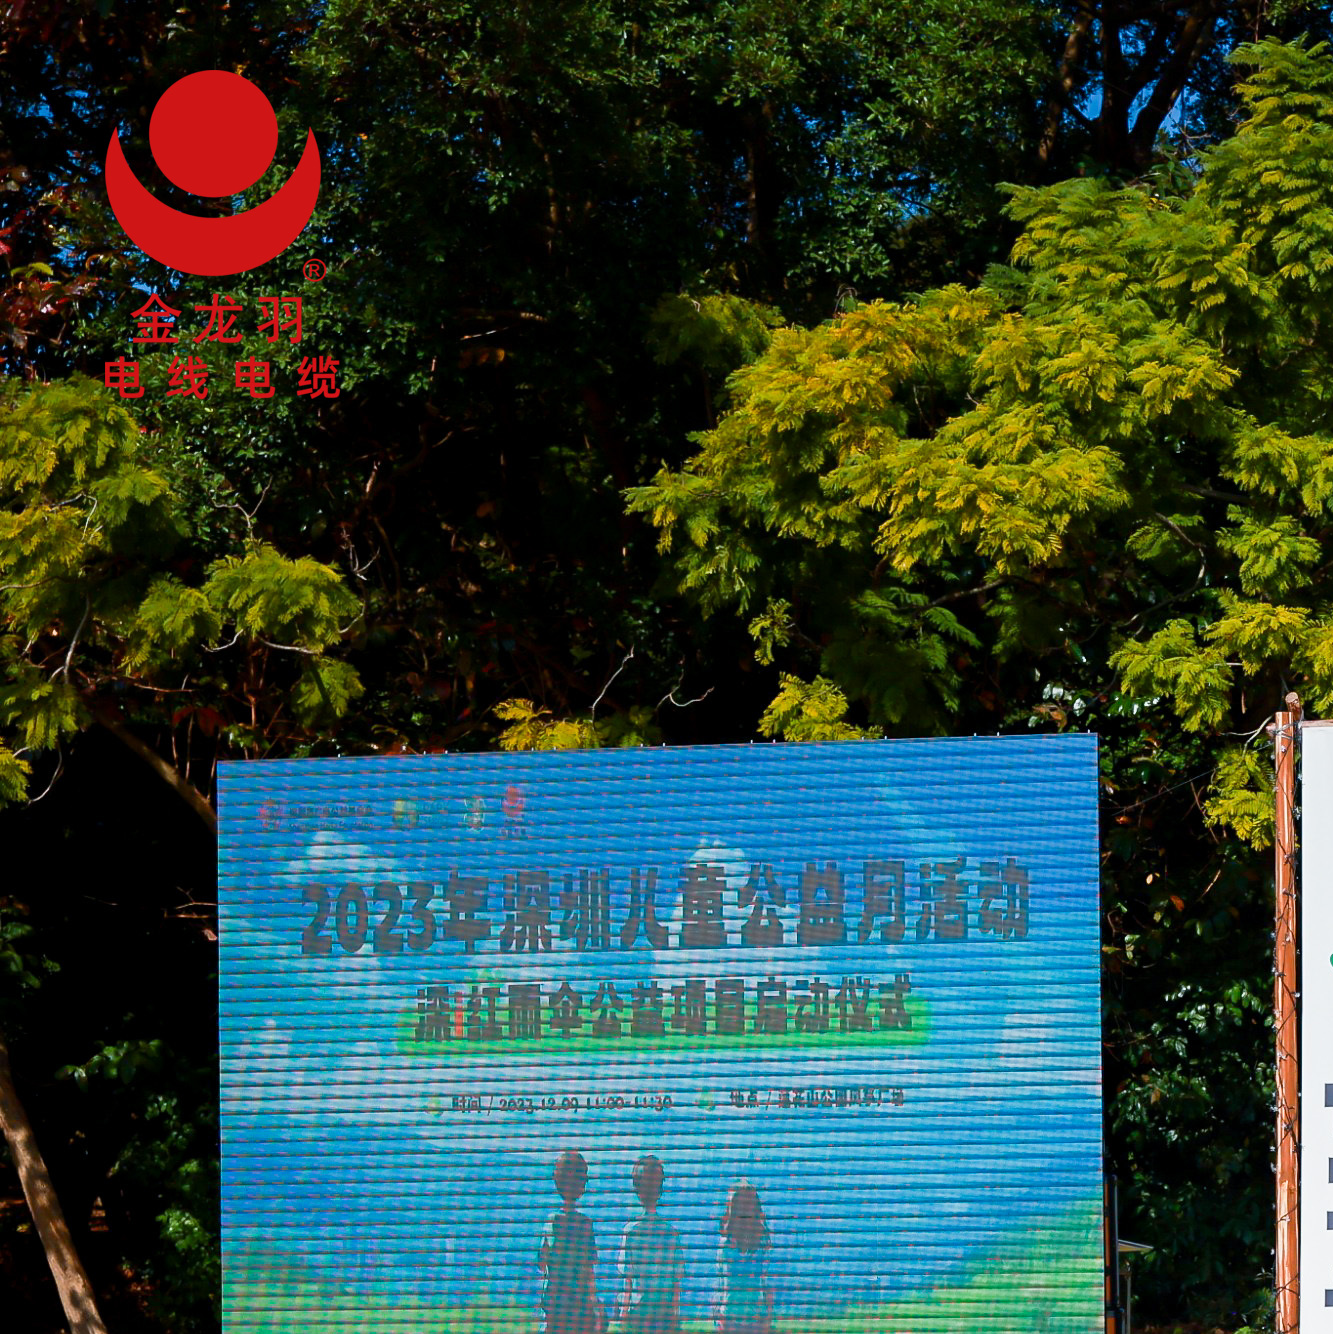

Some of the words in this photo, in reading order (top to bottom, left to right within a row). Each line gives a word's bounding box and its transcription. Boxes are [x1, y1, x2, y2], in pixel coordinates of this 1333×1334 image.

[301, 857, 1029, 954] 2023年深圳儿童公益月活动
[452, 1095, 481, 1114] 时间
